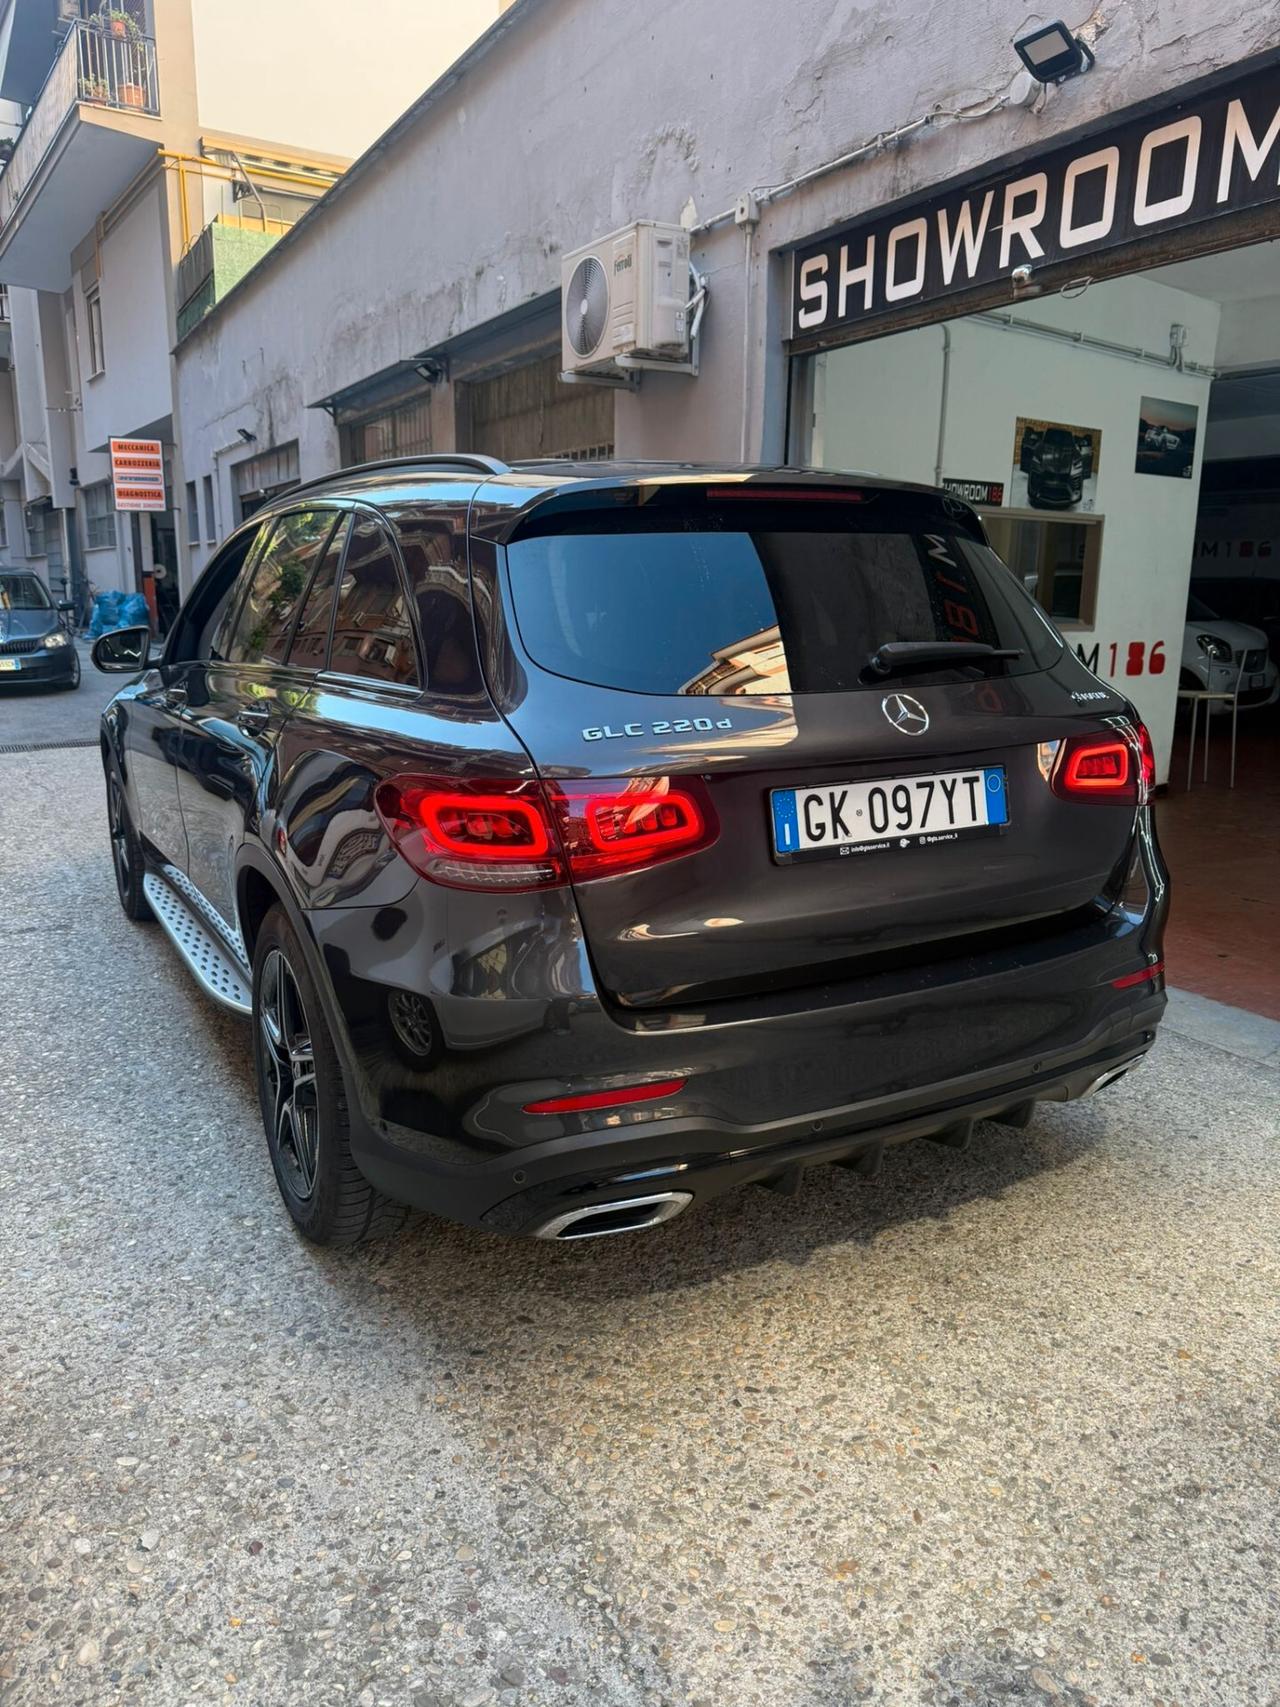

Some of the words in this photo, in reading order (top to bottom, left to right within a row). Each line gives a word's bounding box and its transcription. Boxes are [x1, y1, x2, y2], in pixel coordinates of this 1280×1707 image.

[798, 98, 1280, 330] SHOWROOM
[117, 444, 155, 452] MECCANICA
[114, 459, 160, 467] CARROZZERIA
[117, 490, 162, 498] DIAGNOSTICA
[582, 723, 645, 742] GLC
[651, 718, 733, 735] 220d
